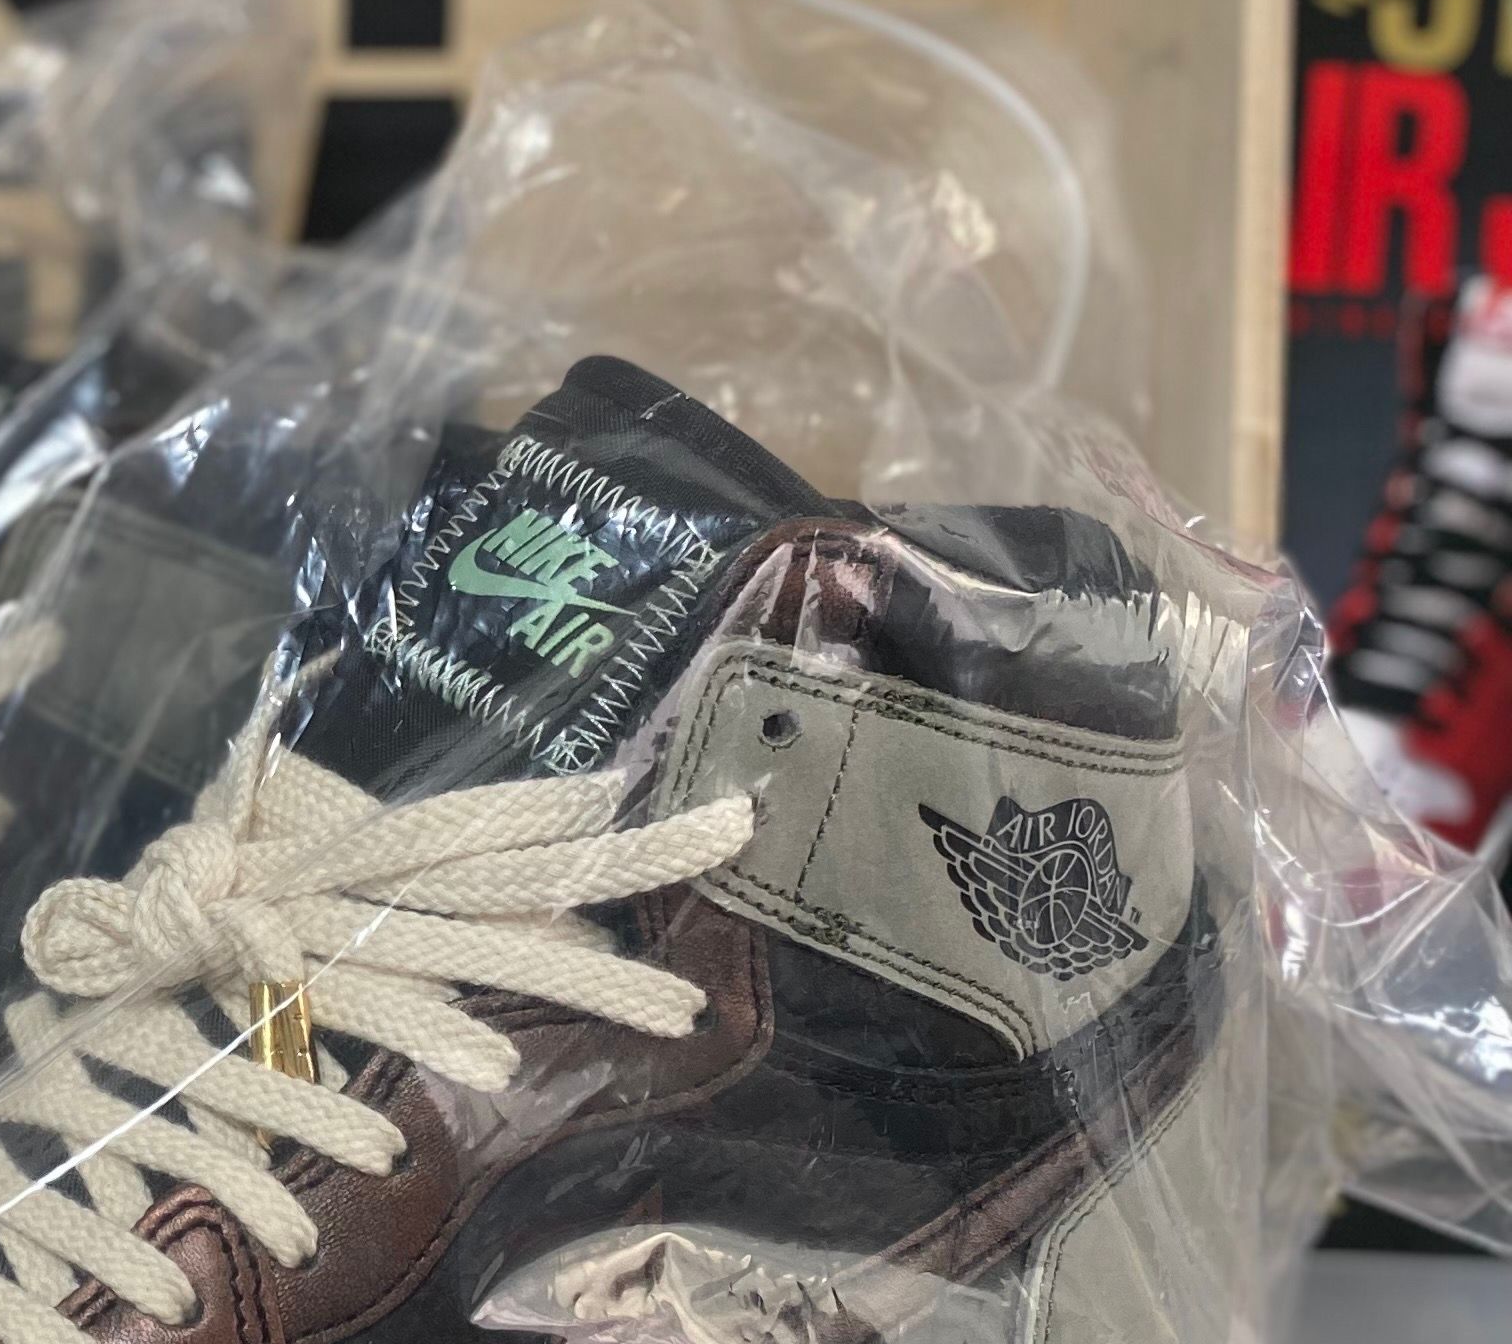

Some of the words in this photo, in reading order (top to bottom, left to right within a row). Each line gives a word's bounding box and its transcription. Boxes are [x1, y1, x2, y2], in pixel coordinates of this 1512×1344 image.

[482, 509, 619, 597] NIKE
[506, 599, 615, 678] AIR
[996, 813, 1056, 850] AIR
